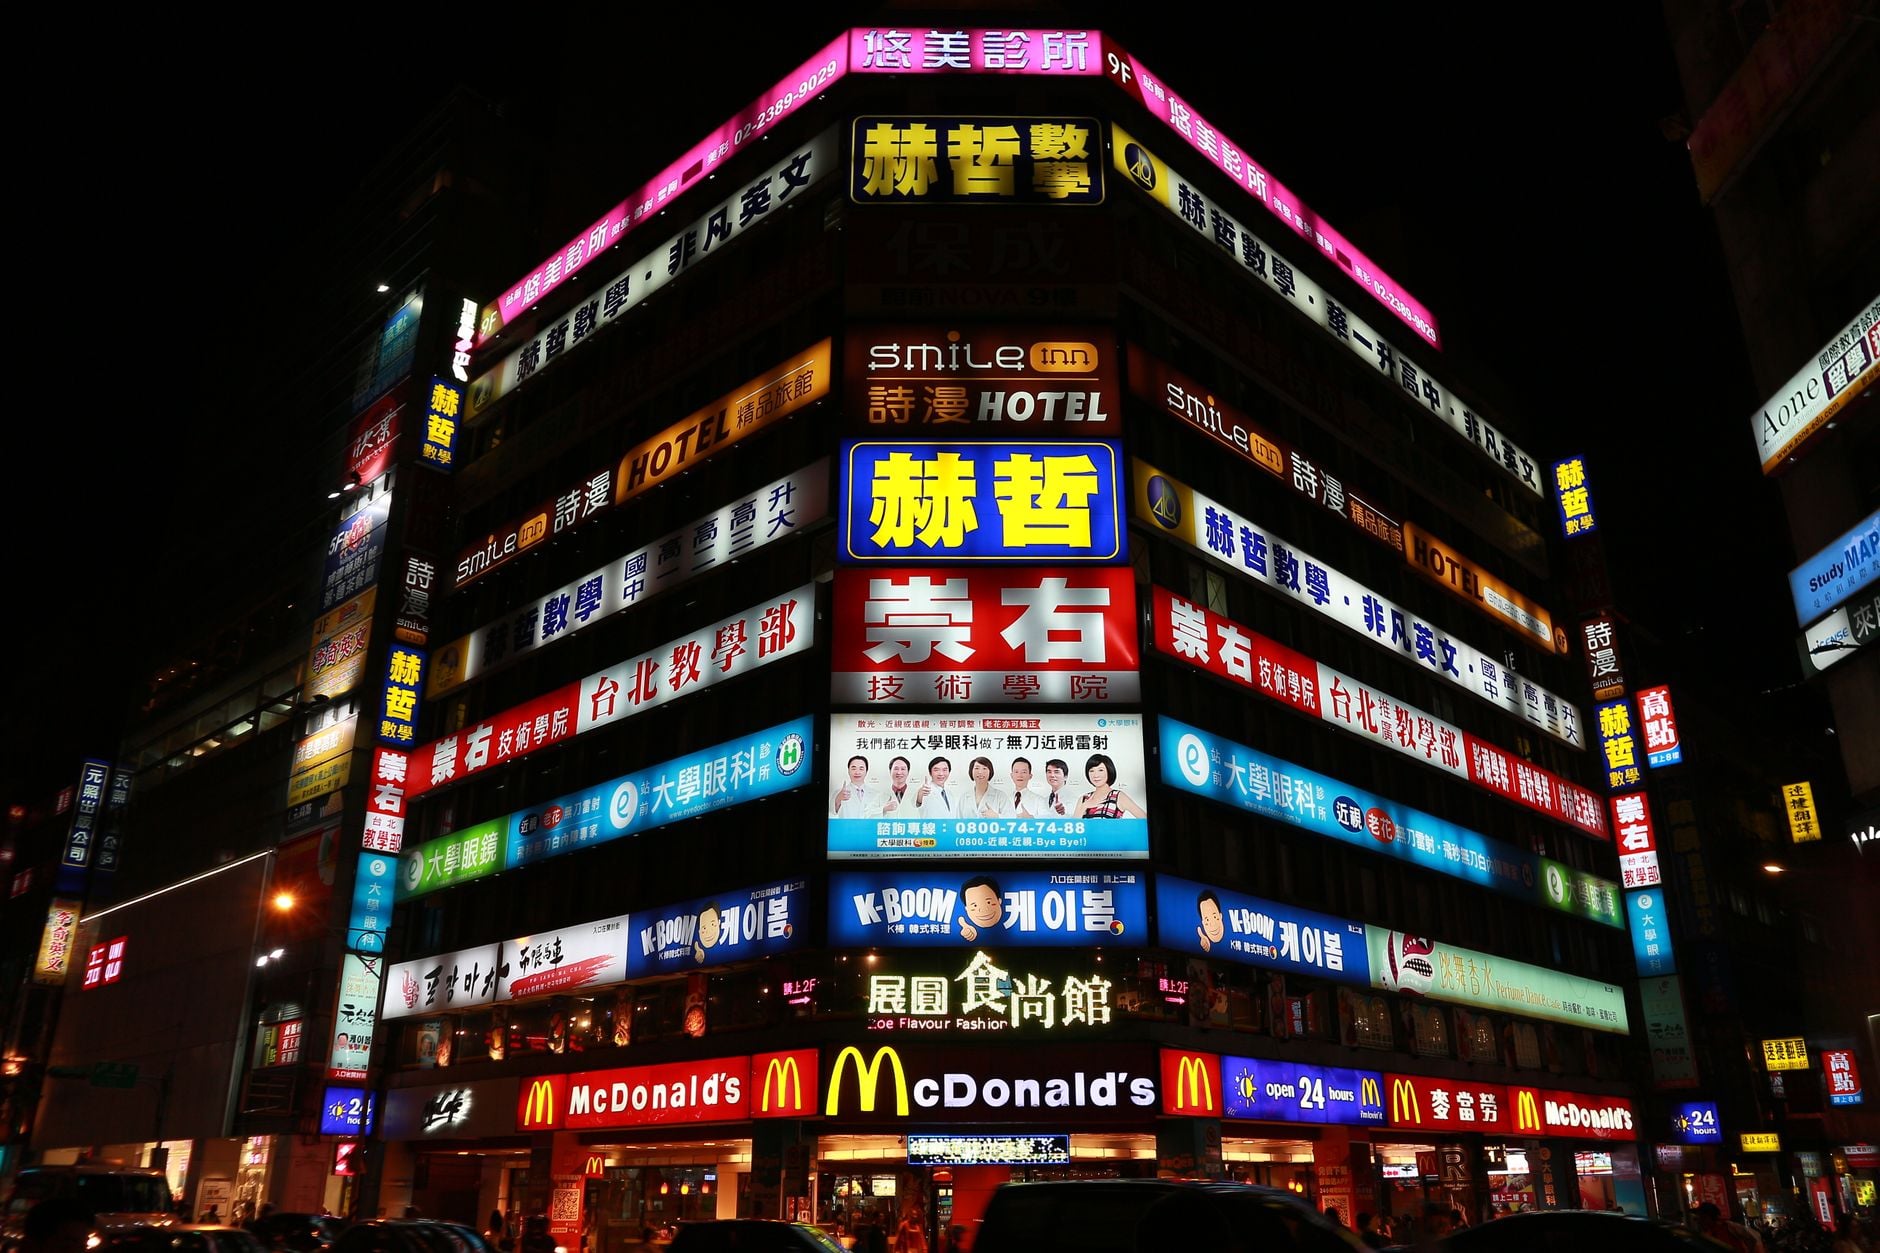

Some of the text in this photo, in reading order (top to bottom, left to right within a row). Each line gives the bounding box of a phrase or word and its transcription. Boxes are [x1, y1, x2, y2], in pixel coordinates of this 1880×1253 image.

[862, 29, 1089, 70] 悠美診所
[1107, 51, 1132, 84] 9F
[1168, 96, 1268, 202] 悠美診所
[862, 122, 1092, 199] 赫哲 數學
[479, 311, 499, 336] 9F
[521, 219, 611, 306] 悠美診所
[733, 59, 838, 147] 02-2389-9029
[516, 274, 631, 377] 赫哲數學
[667, 150, 814, 276] 非凡英文
[1177, 182, 1297, 299] 赫哲數學
[422, 383, 460, 465] 赫哲 數學
[868, 385, 1109, 424] 詩漫 HOTEL
[1762, 376, 1819, 447] Aone
[553, 470, 612, 534] 詩漫
[627, 408, 731, 493] HOTEL
[735, 369, 815, 431] 精品旅館
[868, 451, 1099, 548] 赫哲
[1290, 450, 1348, 519] 詩漫
[1350, 498, 1403, 552] 精品旅館
[1413, 534, 1485, 604] HOTEL
[1555, 458, 1596, 536] 赫哲 數學
[401, 557, 435, 621] 詩漫
[1808, 561, 1845, 593] Study
[1843, 529, 1880, 571] MAP
[862, 576, 1111, 665] 崇右
[1204, 505, 1331, 607] 赫哲數學
[1362, 594, 1460, 679] 非凡英文
[1170, 596, 1316, 710] 崇右 技術學院
[1584, 621, 1620, 679] 詩漫
[388, 650, 422, 722] 赫哲
[430, 597, 799, 787] 崇右 技術學院 台北教學部
[867, 674, 1108, 701] 技術學院
[380, 720, 414, 742] 數學
[1599, 703, 1635, 770] 赫哲
[1640, 690, 1676, 749] 高點
[374, 752, 408, 813] 崇右
[651, 745, 756, 815] 大學眼科
[1223, 754, 1316, 819] 大學眼科
[1336, 801, 1364, 831] 近視
[1368, 813, 1394, 842] 老花
[1609, 767, 1641, 789] 數學
[364, 829, 402, 853] 教學部
[955, 821, 1086, 834] 0800-74-74-88
[1616, 795, 1650, 851] 崇右
[426, 831, 499, 882] 大學眼鏡
[1623, 865, 1660, 886] 教學部
[361, 882, 383, 947] 大學眼科
[640, 895, 790, 956] K-BOOM 케이봄
[853, 887, 1116, 932] K-BOOM 케이봄
[908, 923, 952, 935] 韓式料理
[1228, 909, 1344, 971] K-BOOM 케이봄
[1641, 913, 1662, 972] 大學眼科
[899, 1016, 1008, 1030] Flavour Fashion
[568, 1071, 741, 1115] McDonald's
[1266, 1076, 1355, 1110] open 24 hours
[1828, 1052, 1856, 1091] 高點
[1430, 1087, 1633, 1131] 麥當勞 McDonald's
[1691, 1110, 1715, 1126] 24
[1693, 1127, 1717, 1135] hours
